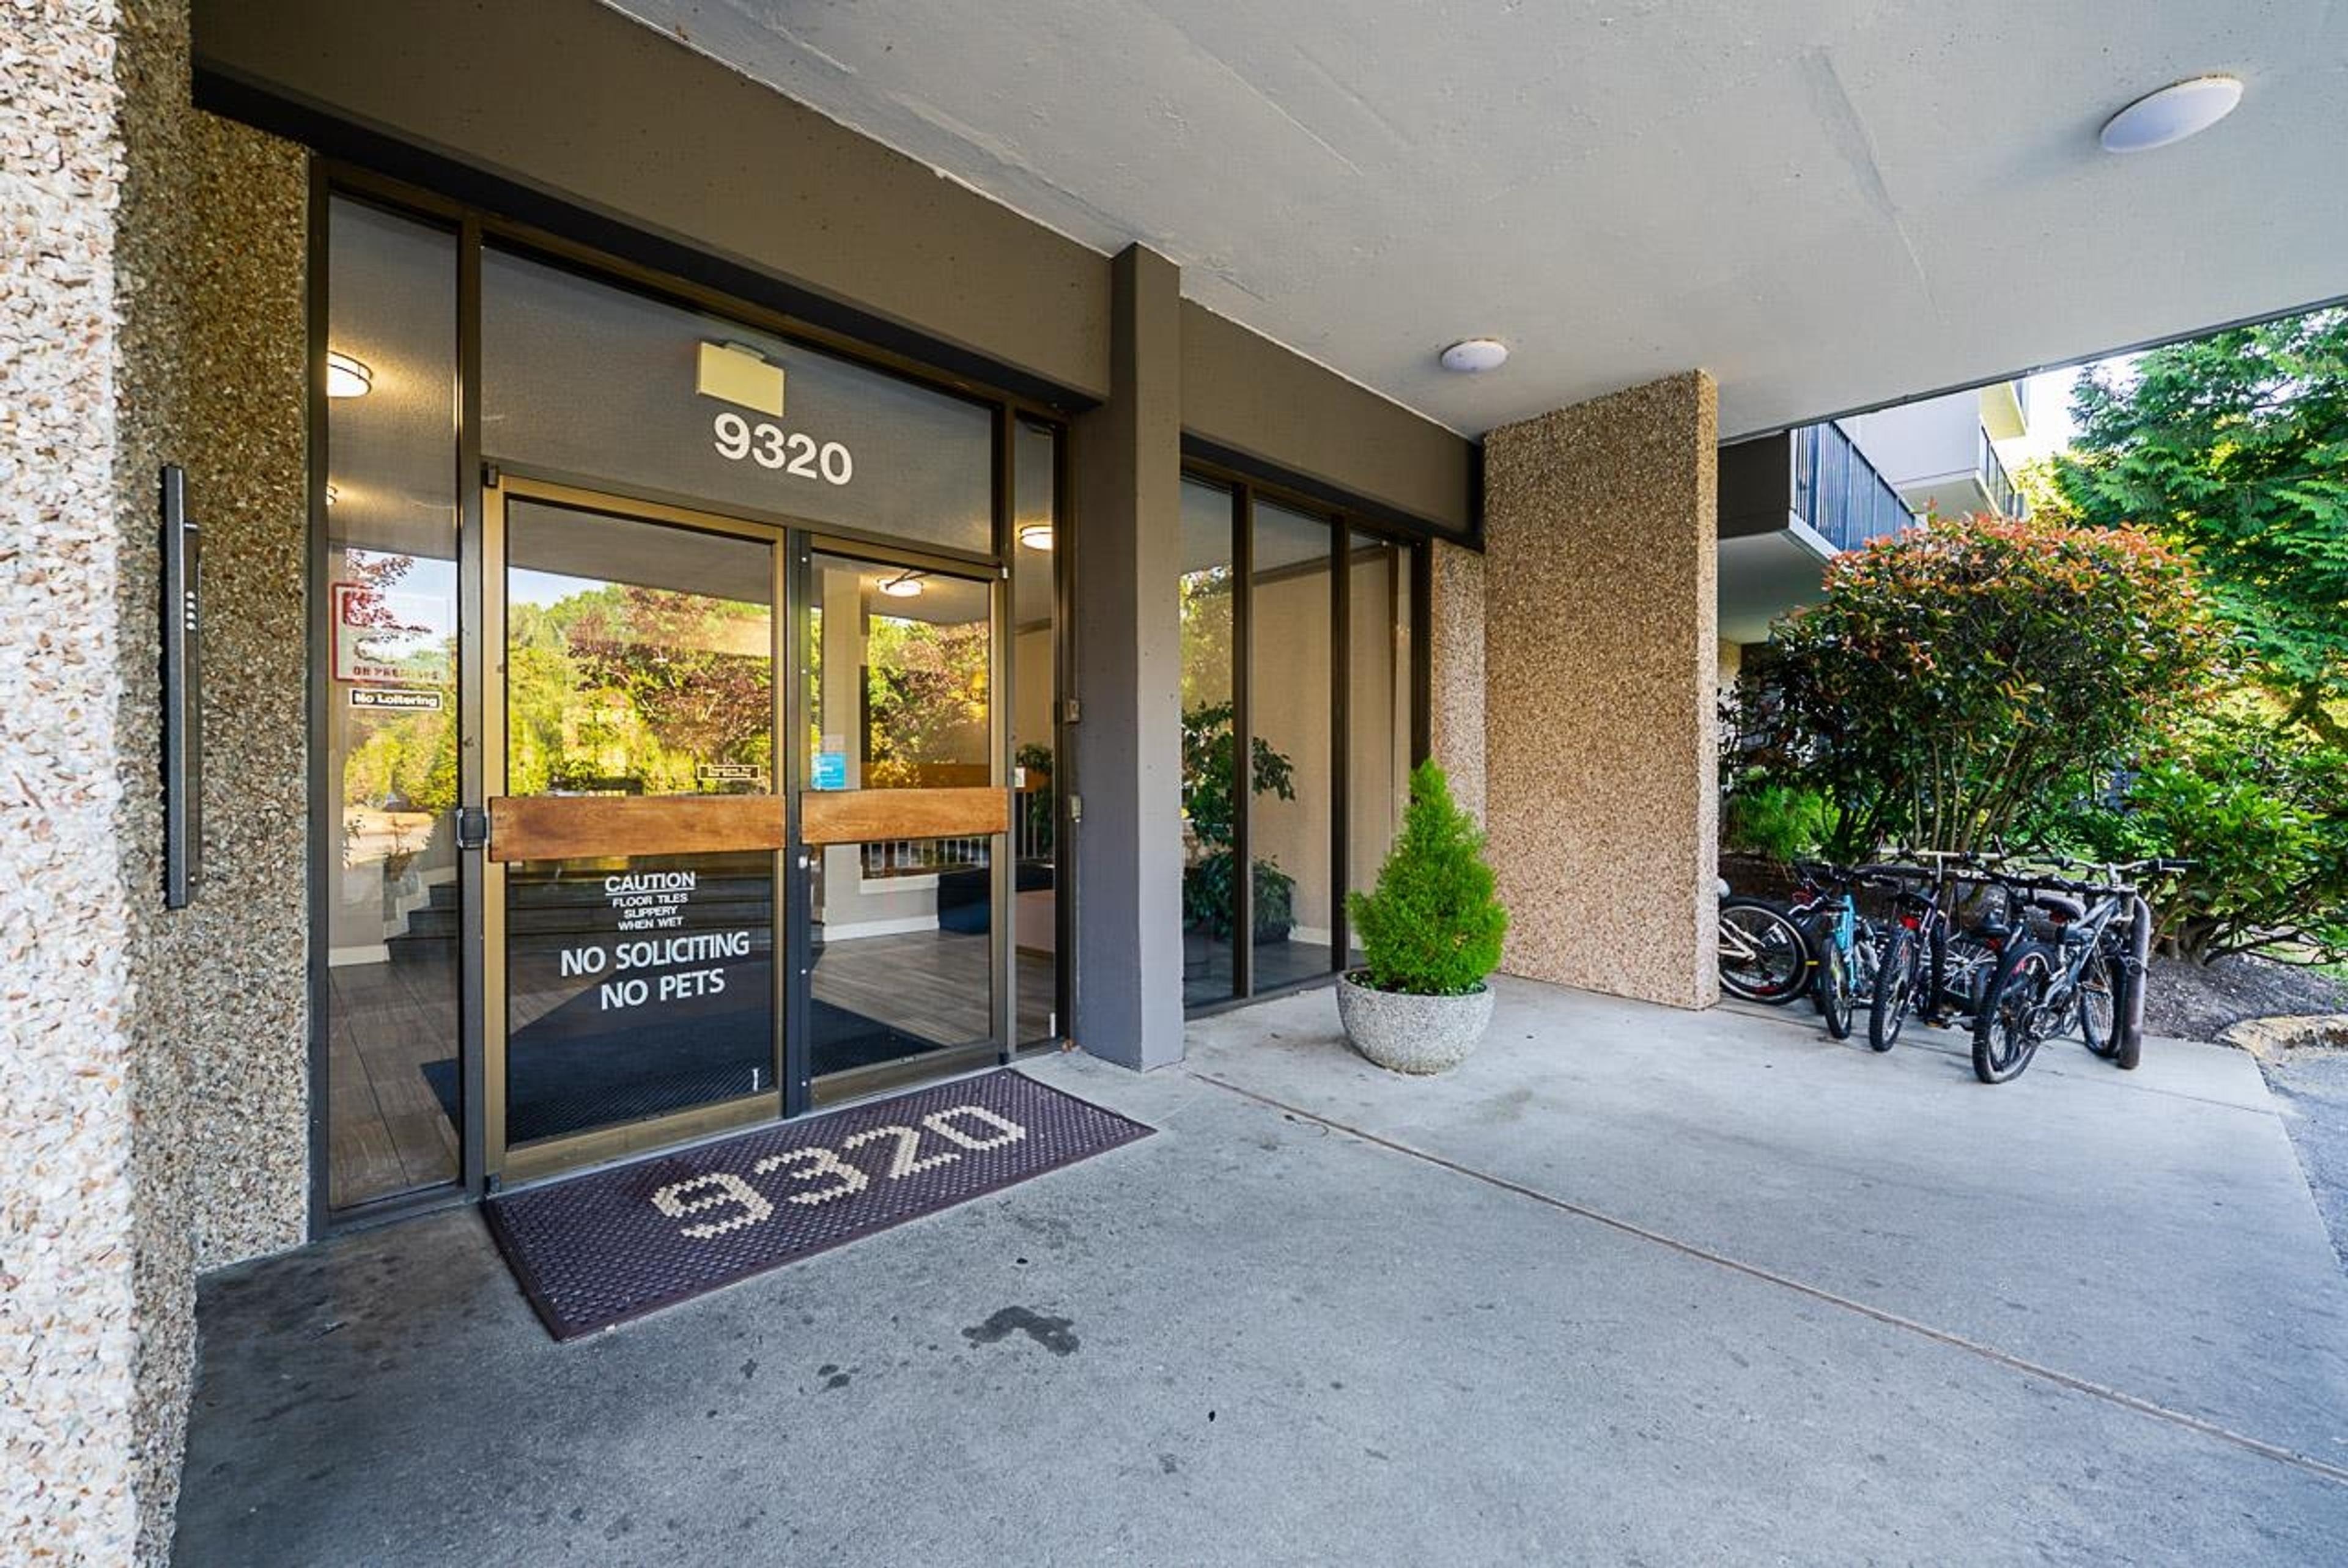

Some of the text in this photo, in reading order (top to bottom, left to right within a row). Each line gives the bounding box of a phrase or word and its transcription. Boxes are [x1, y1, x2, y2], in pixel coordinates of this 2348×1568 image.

[714, 413, 852, 485] 9320
[355, 693, 438, 707] No Loitering
[605, 872, 695, 893] CAUTION
[612, 893, 689, 908] FLOOR TILES
[624, 906, 678, 919] SLIPPERY
[618, 917, 684, 930] WHEN WET
[561, 931, 750, 976] NO SOLICITING
[601, 968, 725, 1010] NO PETS
[650, 1105, 1026, 1239] 9320
